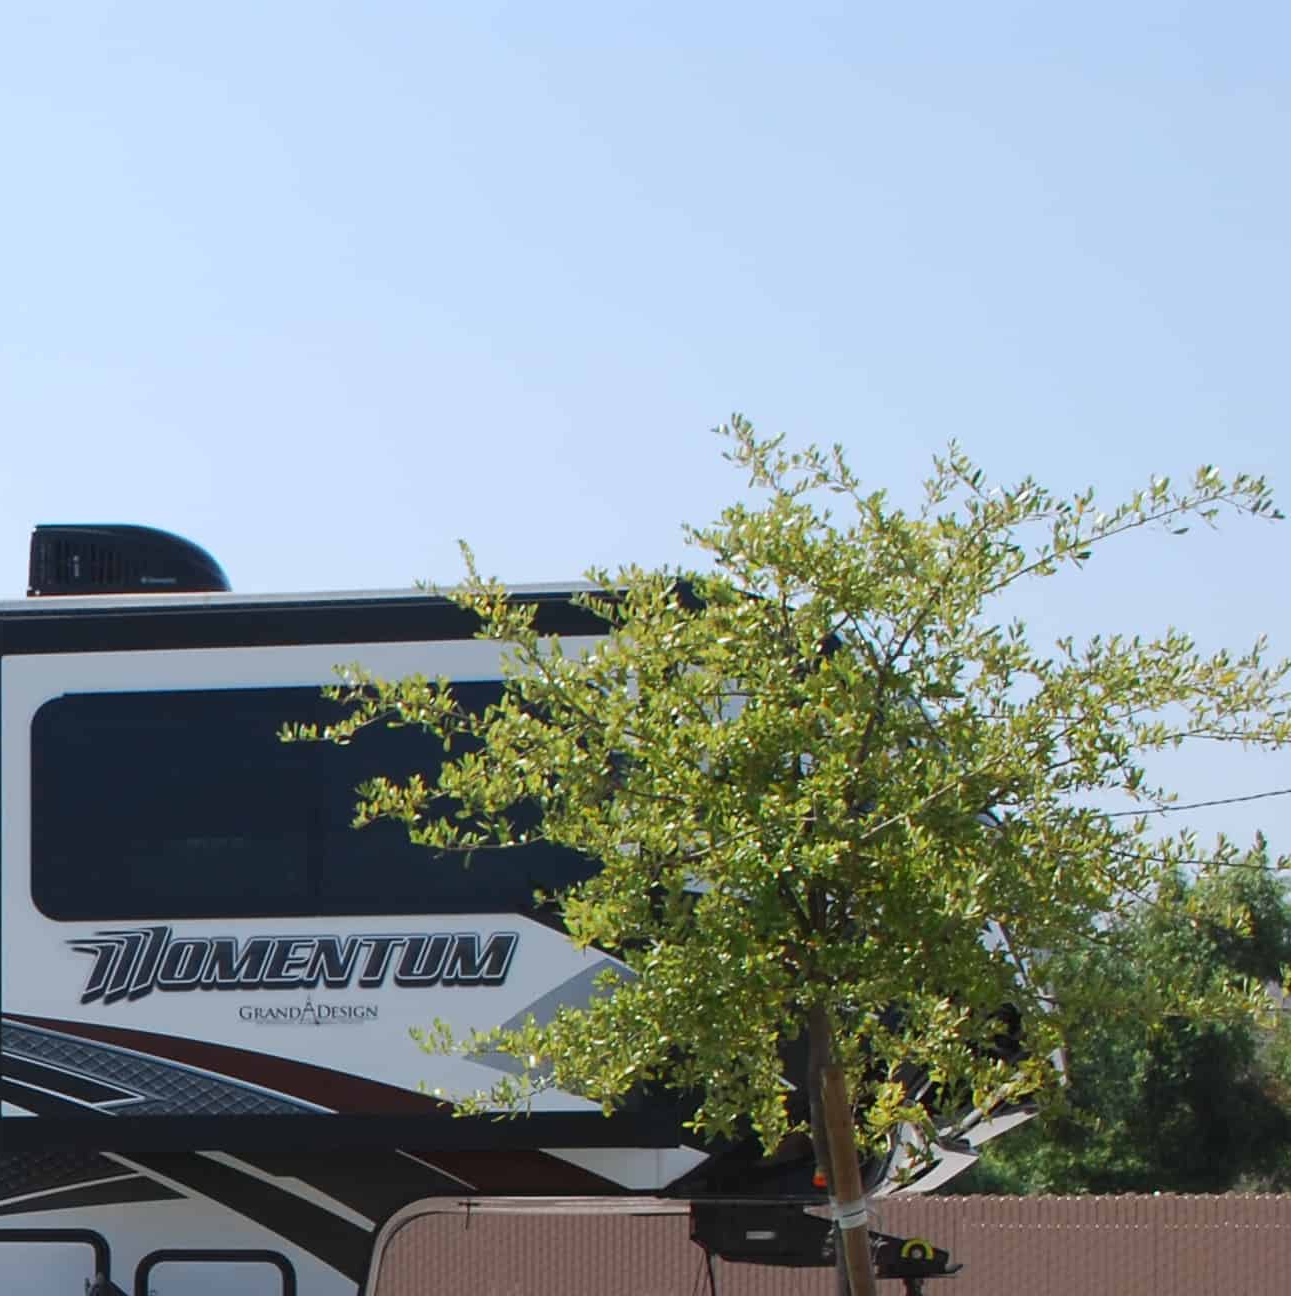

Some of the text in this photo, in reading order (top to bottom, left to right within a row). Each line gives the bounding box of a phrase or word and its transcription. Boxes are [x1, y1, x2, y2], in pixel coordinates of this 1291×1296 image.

[64, 923, 518, 1004] MOMENTUM
[239, 1003, 379, 1021] GRAND DESIGN
